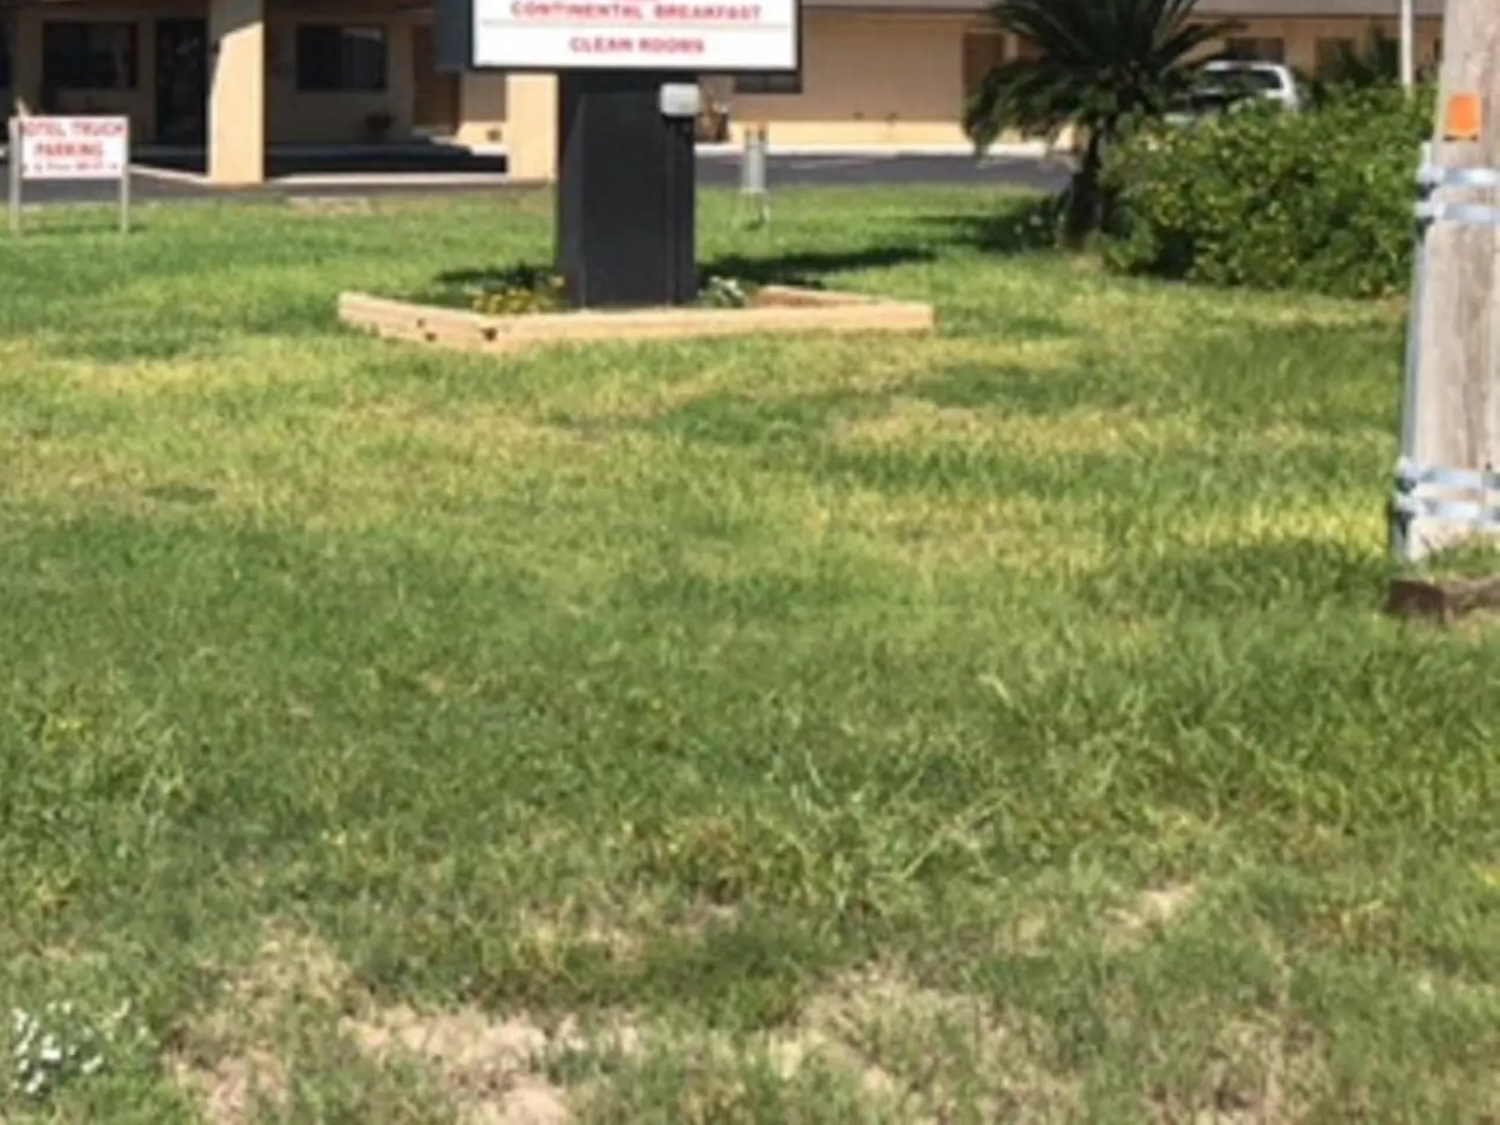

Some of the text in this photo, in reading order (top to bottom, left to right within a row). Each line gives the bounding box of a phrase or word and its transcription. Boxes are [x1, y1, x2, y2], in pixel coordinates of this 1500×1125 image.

[509, 0, 761, 21] CONTINENTAL BREAKFAST
[568, 36, 705, 54] CLEAN ROOMS
[34, 142, 104, 157] PARKING
